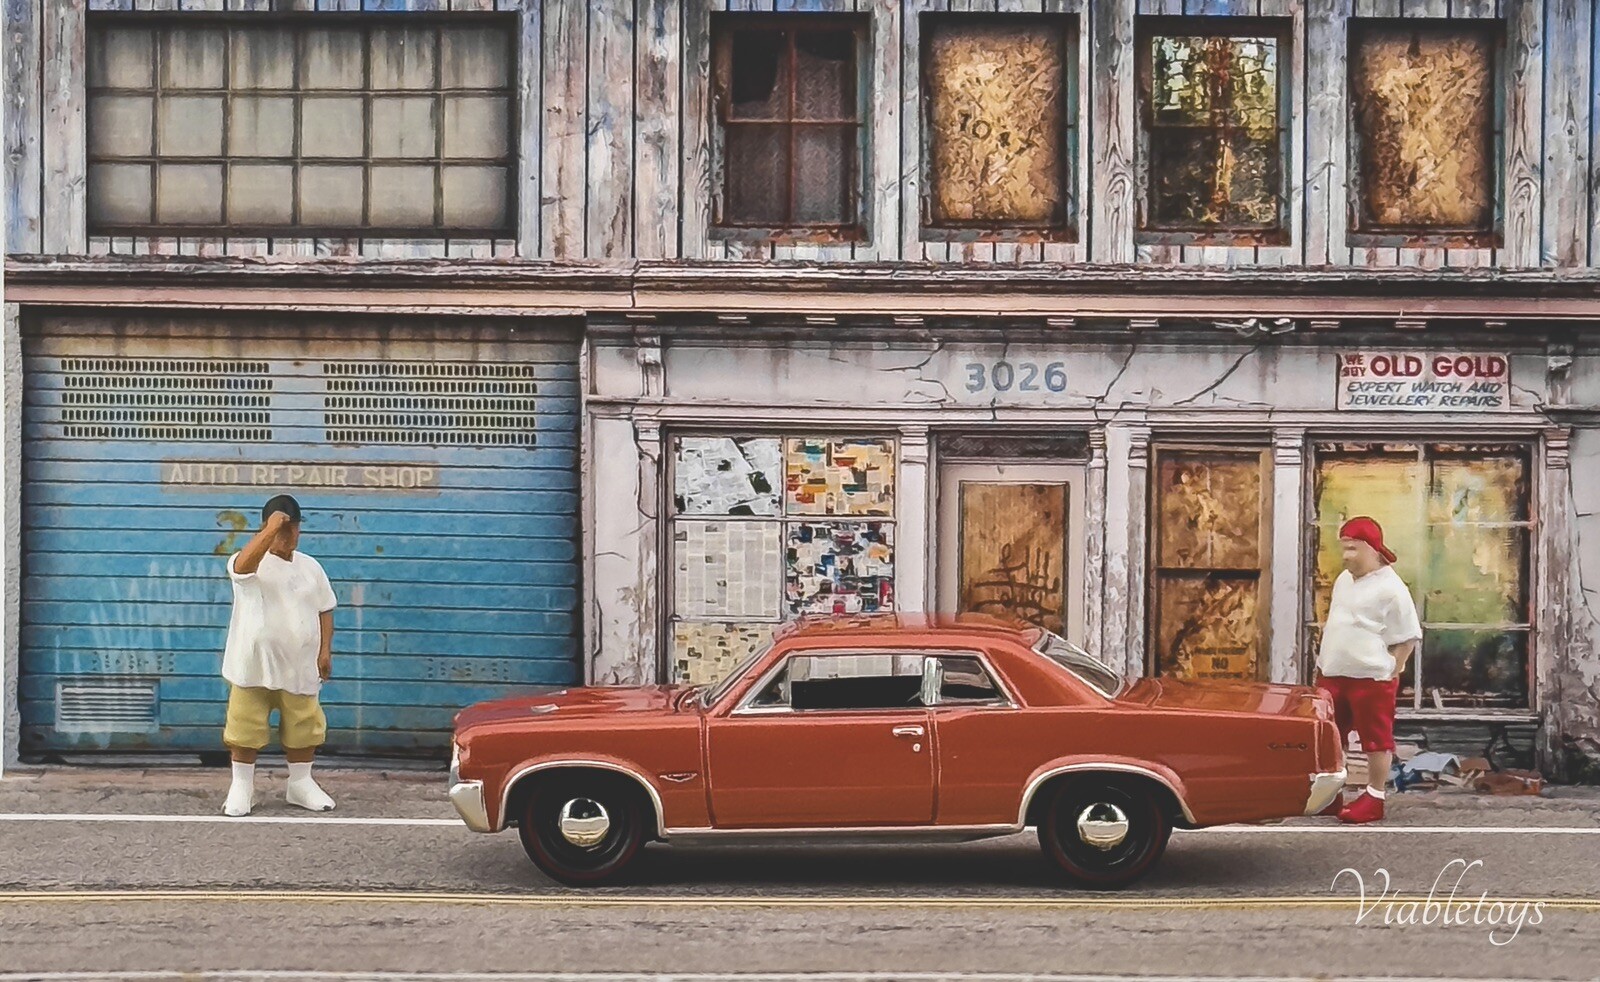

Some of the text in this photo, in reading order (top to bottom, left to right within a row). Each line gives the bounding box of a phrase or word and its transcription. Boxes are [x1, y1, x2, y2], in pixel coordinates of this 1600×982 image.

[1344, 354, 1364, 365] WE
[1370, 355, 1506, 378] OLD GOLD
[965, 360, 1067, 393] 3026
[1347, 381, 1502, 393] EXPERT WATCH AND
[1345, 394, 1503, 407] JEWELLERY REPAIRS
[169, 463, 433, 488] AUTO REPAIR SHOP
